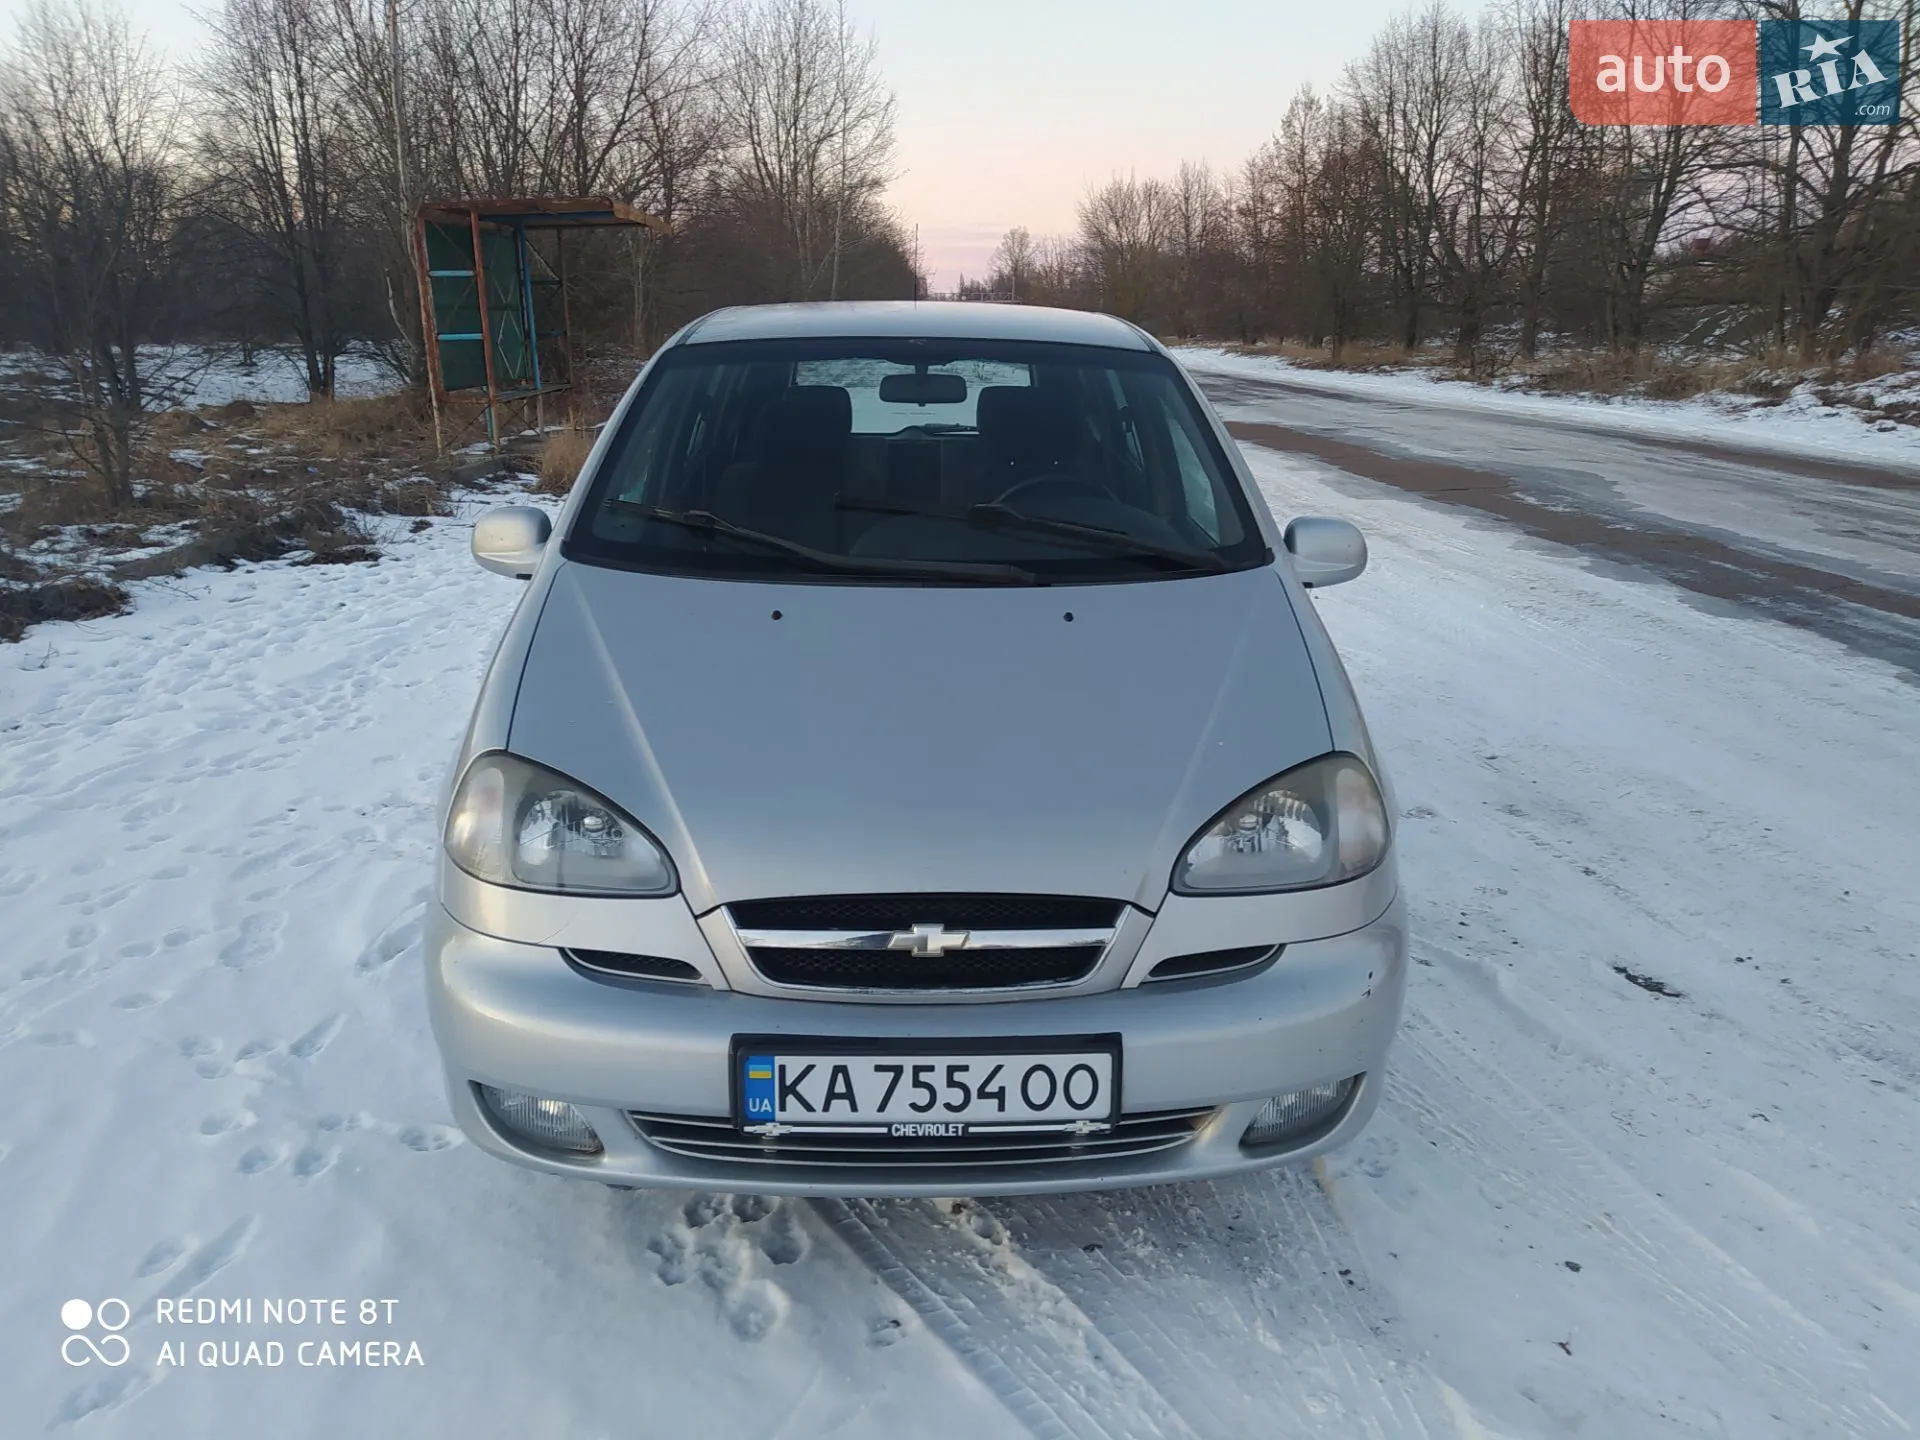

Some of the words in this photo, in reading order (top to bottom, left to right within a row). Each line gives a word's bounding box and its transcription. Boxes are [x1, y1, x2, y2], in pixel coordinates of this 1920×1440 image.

[778, 1064, 859, 1113] KA
[873, 1064, 1006, 1113] 7554
[749, 1098, 772, 1113] UA
[891, 1123, 965, 1137] CHEVROLET
